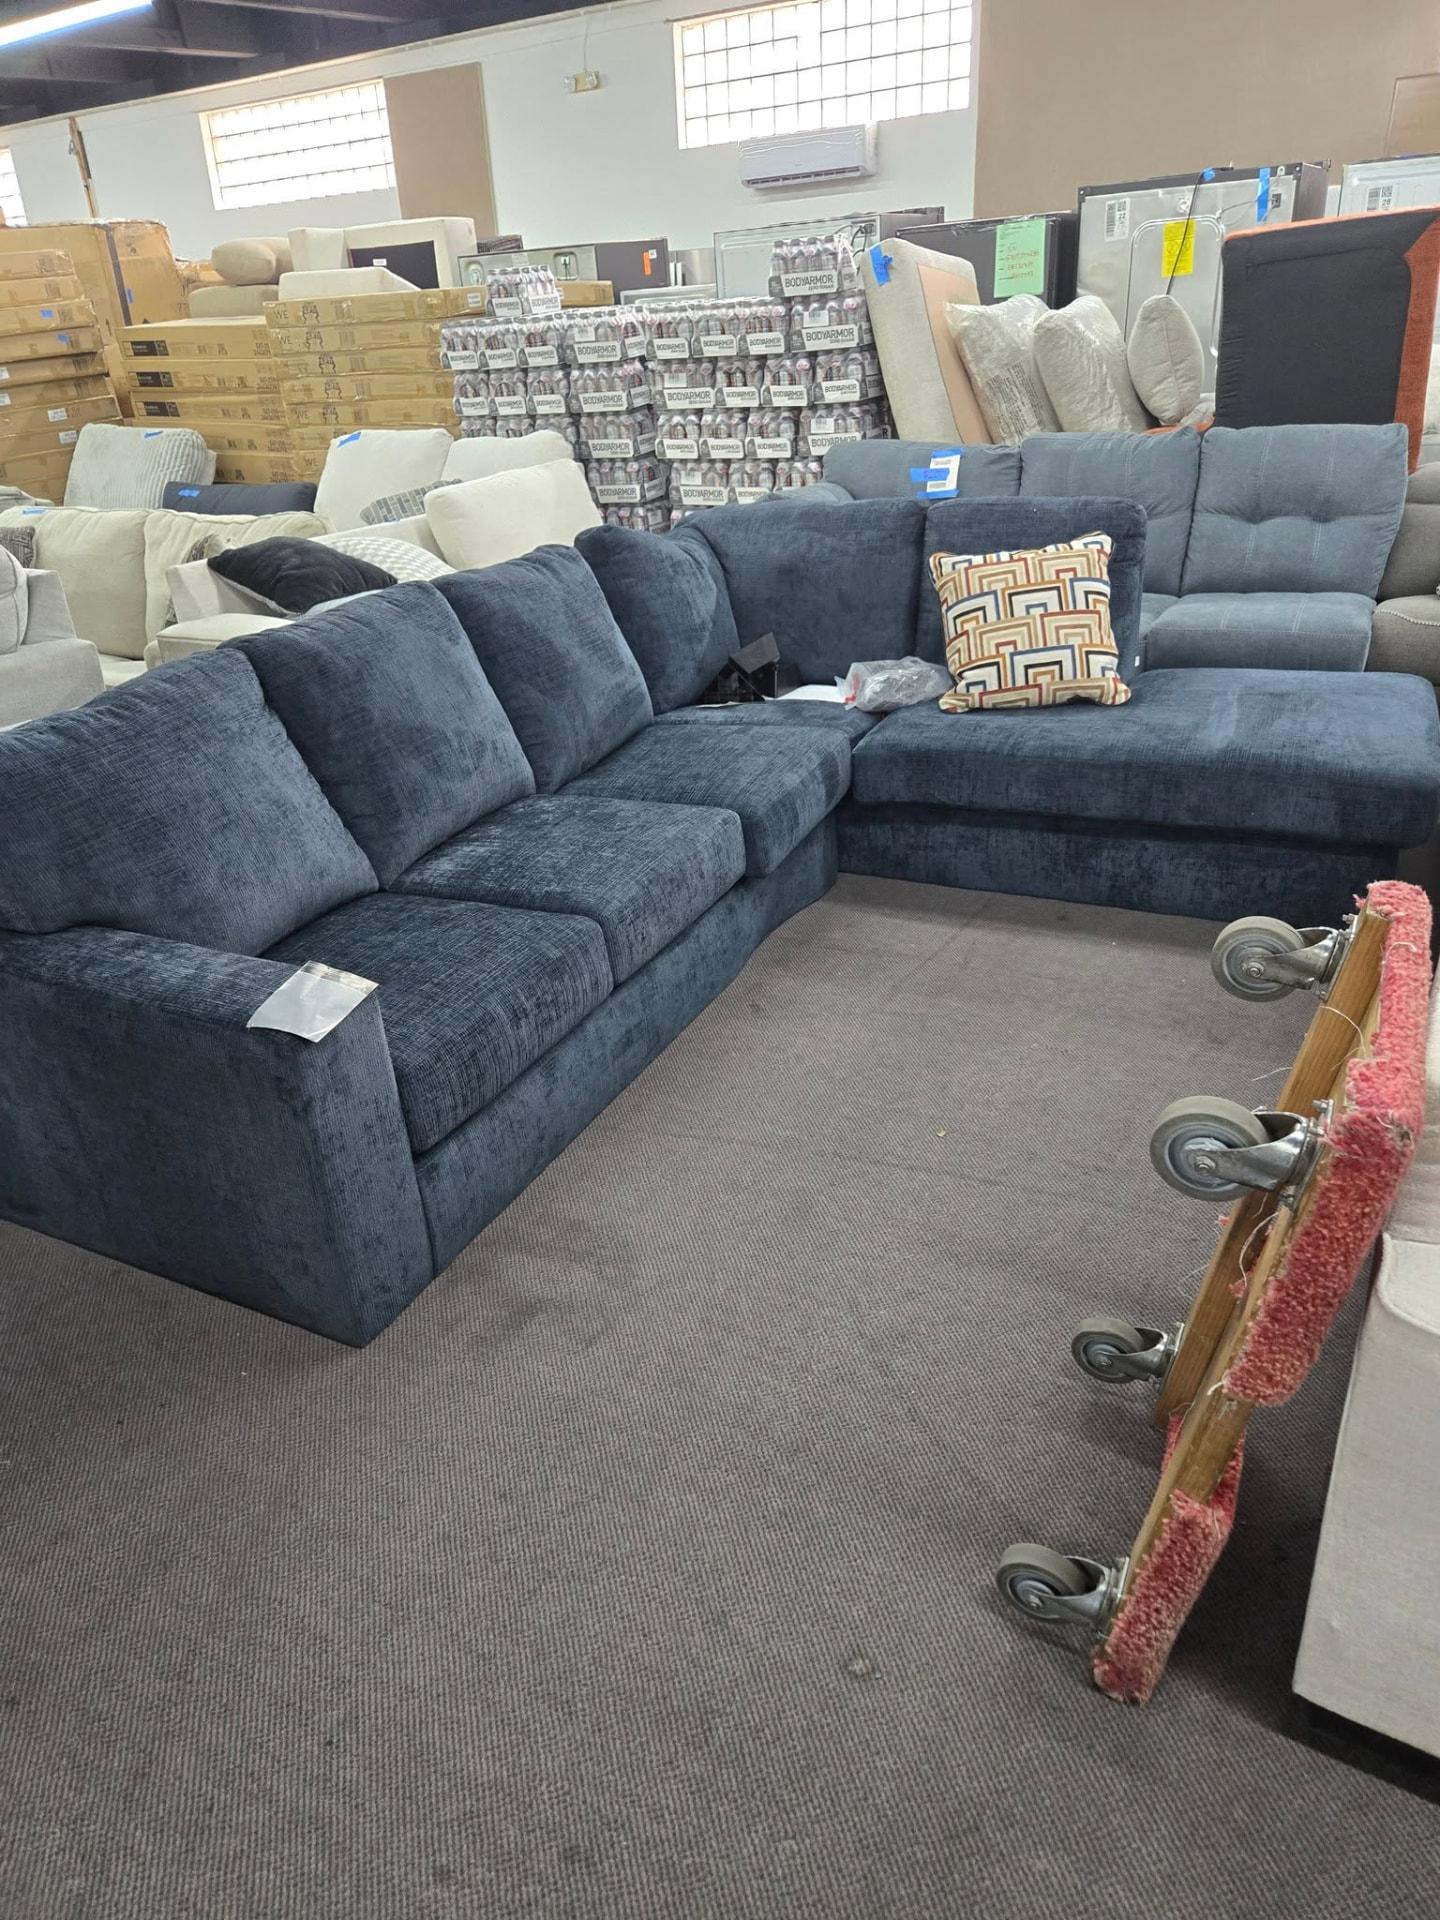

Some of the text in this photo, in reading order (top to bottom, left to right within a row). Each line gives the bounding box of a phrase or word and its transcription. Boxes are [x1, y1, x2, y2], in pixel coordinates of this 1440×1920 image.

[784, 274, 834, 288] BODYARMOR
[805, 328, 854, 341] BODYARMOR
[703, 339, 734, 347] BODYARMOR
[749, 337, 781, 346] BODYARMOR
[577, 344, 617, 355] BODYARMOR
[656, 342, 686, 351] BODYARMOR
[824, 383, 858, 393] BODYARMOR
[667, 391, 711, 401] BODYARMOR
[725, 390, 756, 398] BODYARMOR
[582, 395, 623, 405] BODYARMOR
[592, 442, 630, 451] BODYARMOR
[757, 442, 788, 450] BODYARMOR
[599, 488, 637, 497] BODYARMOR
[683, 488, 723, 498] BODYARMOR
